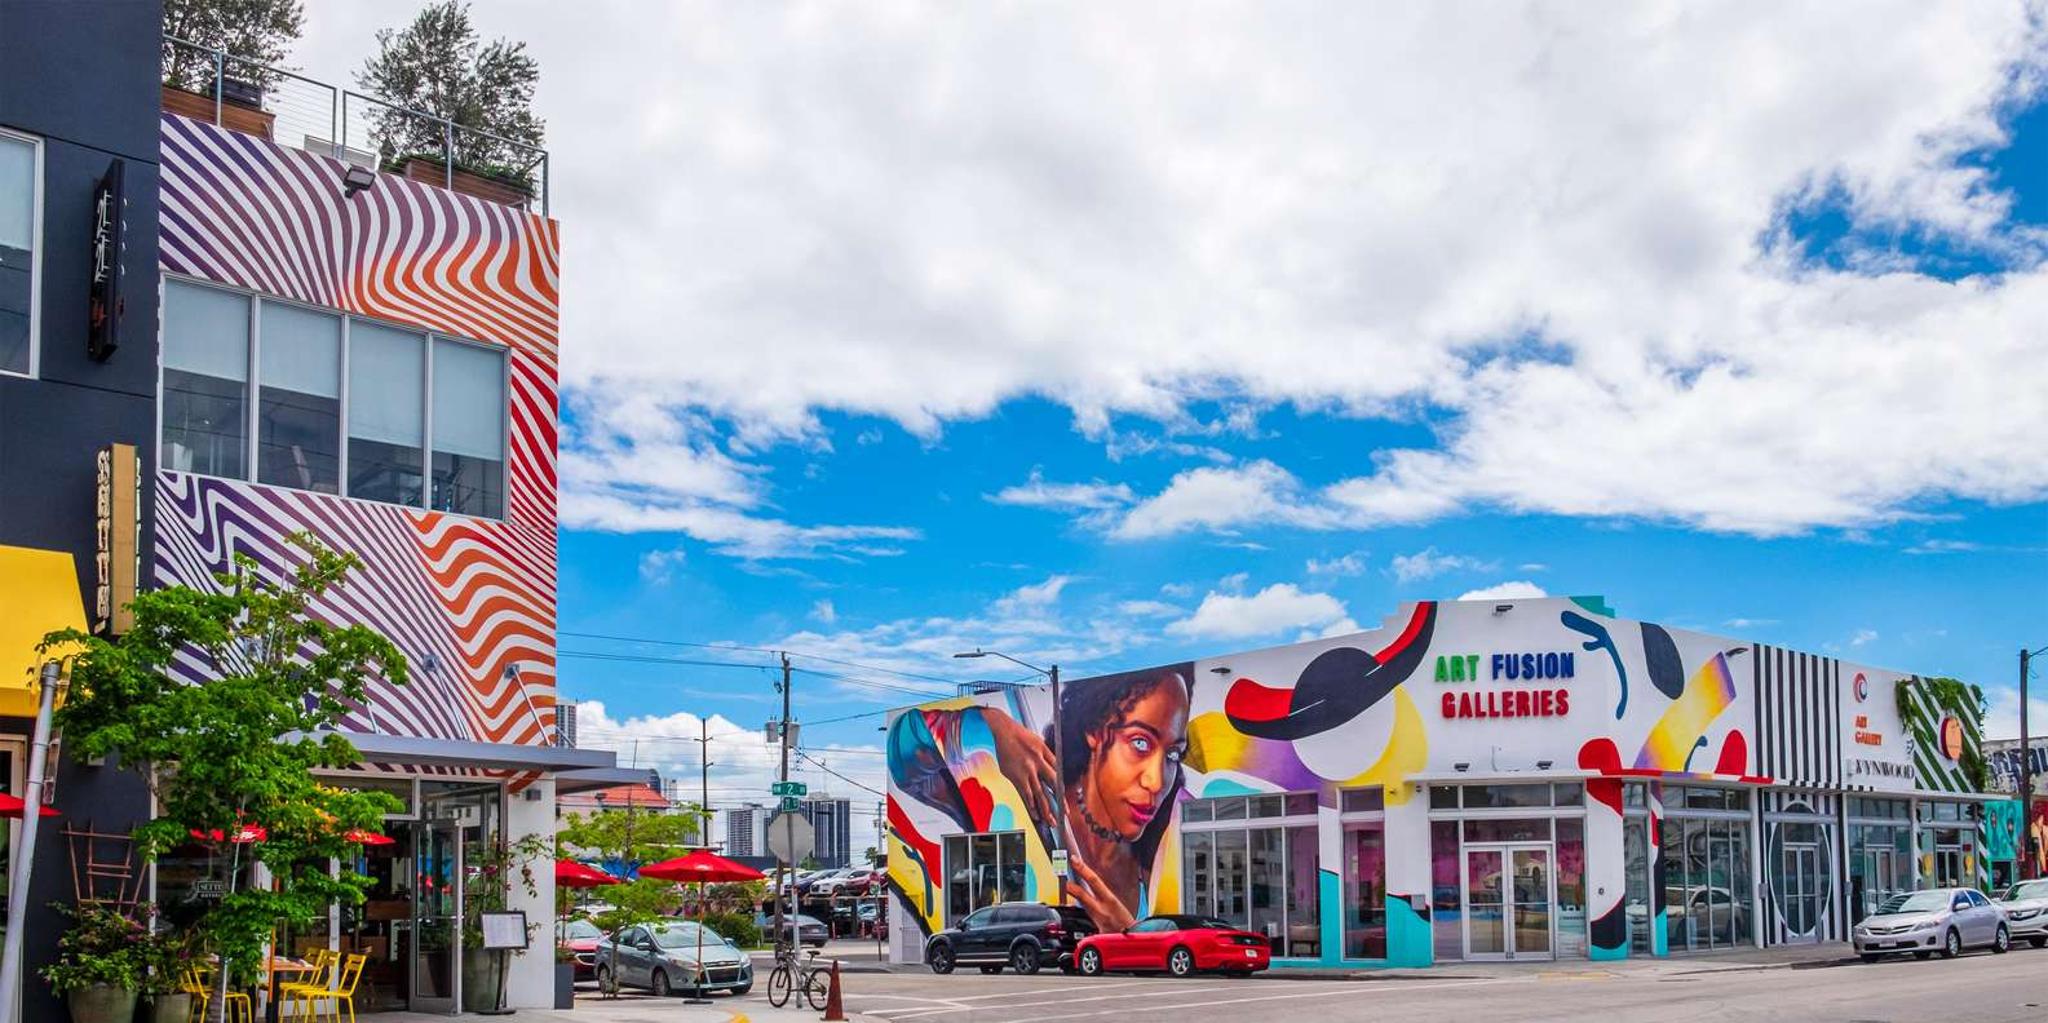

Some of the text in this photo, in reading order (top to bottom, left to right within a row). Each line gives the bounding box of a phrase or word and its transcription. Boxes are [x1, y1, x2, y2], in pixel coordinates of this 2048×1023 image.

[1434, 652, 1575, 682] ART FUSION
[1441, 688, 1570, 719] GALLERIES
[787, 783, 794, 795] 2
